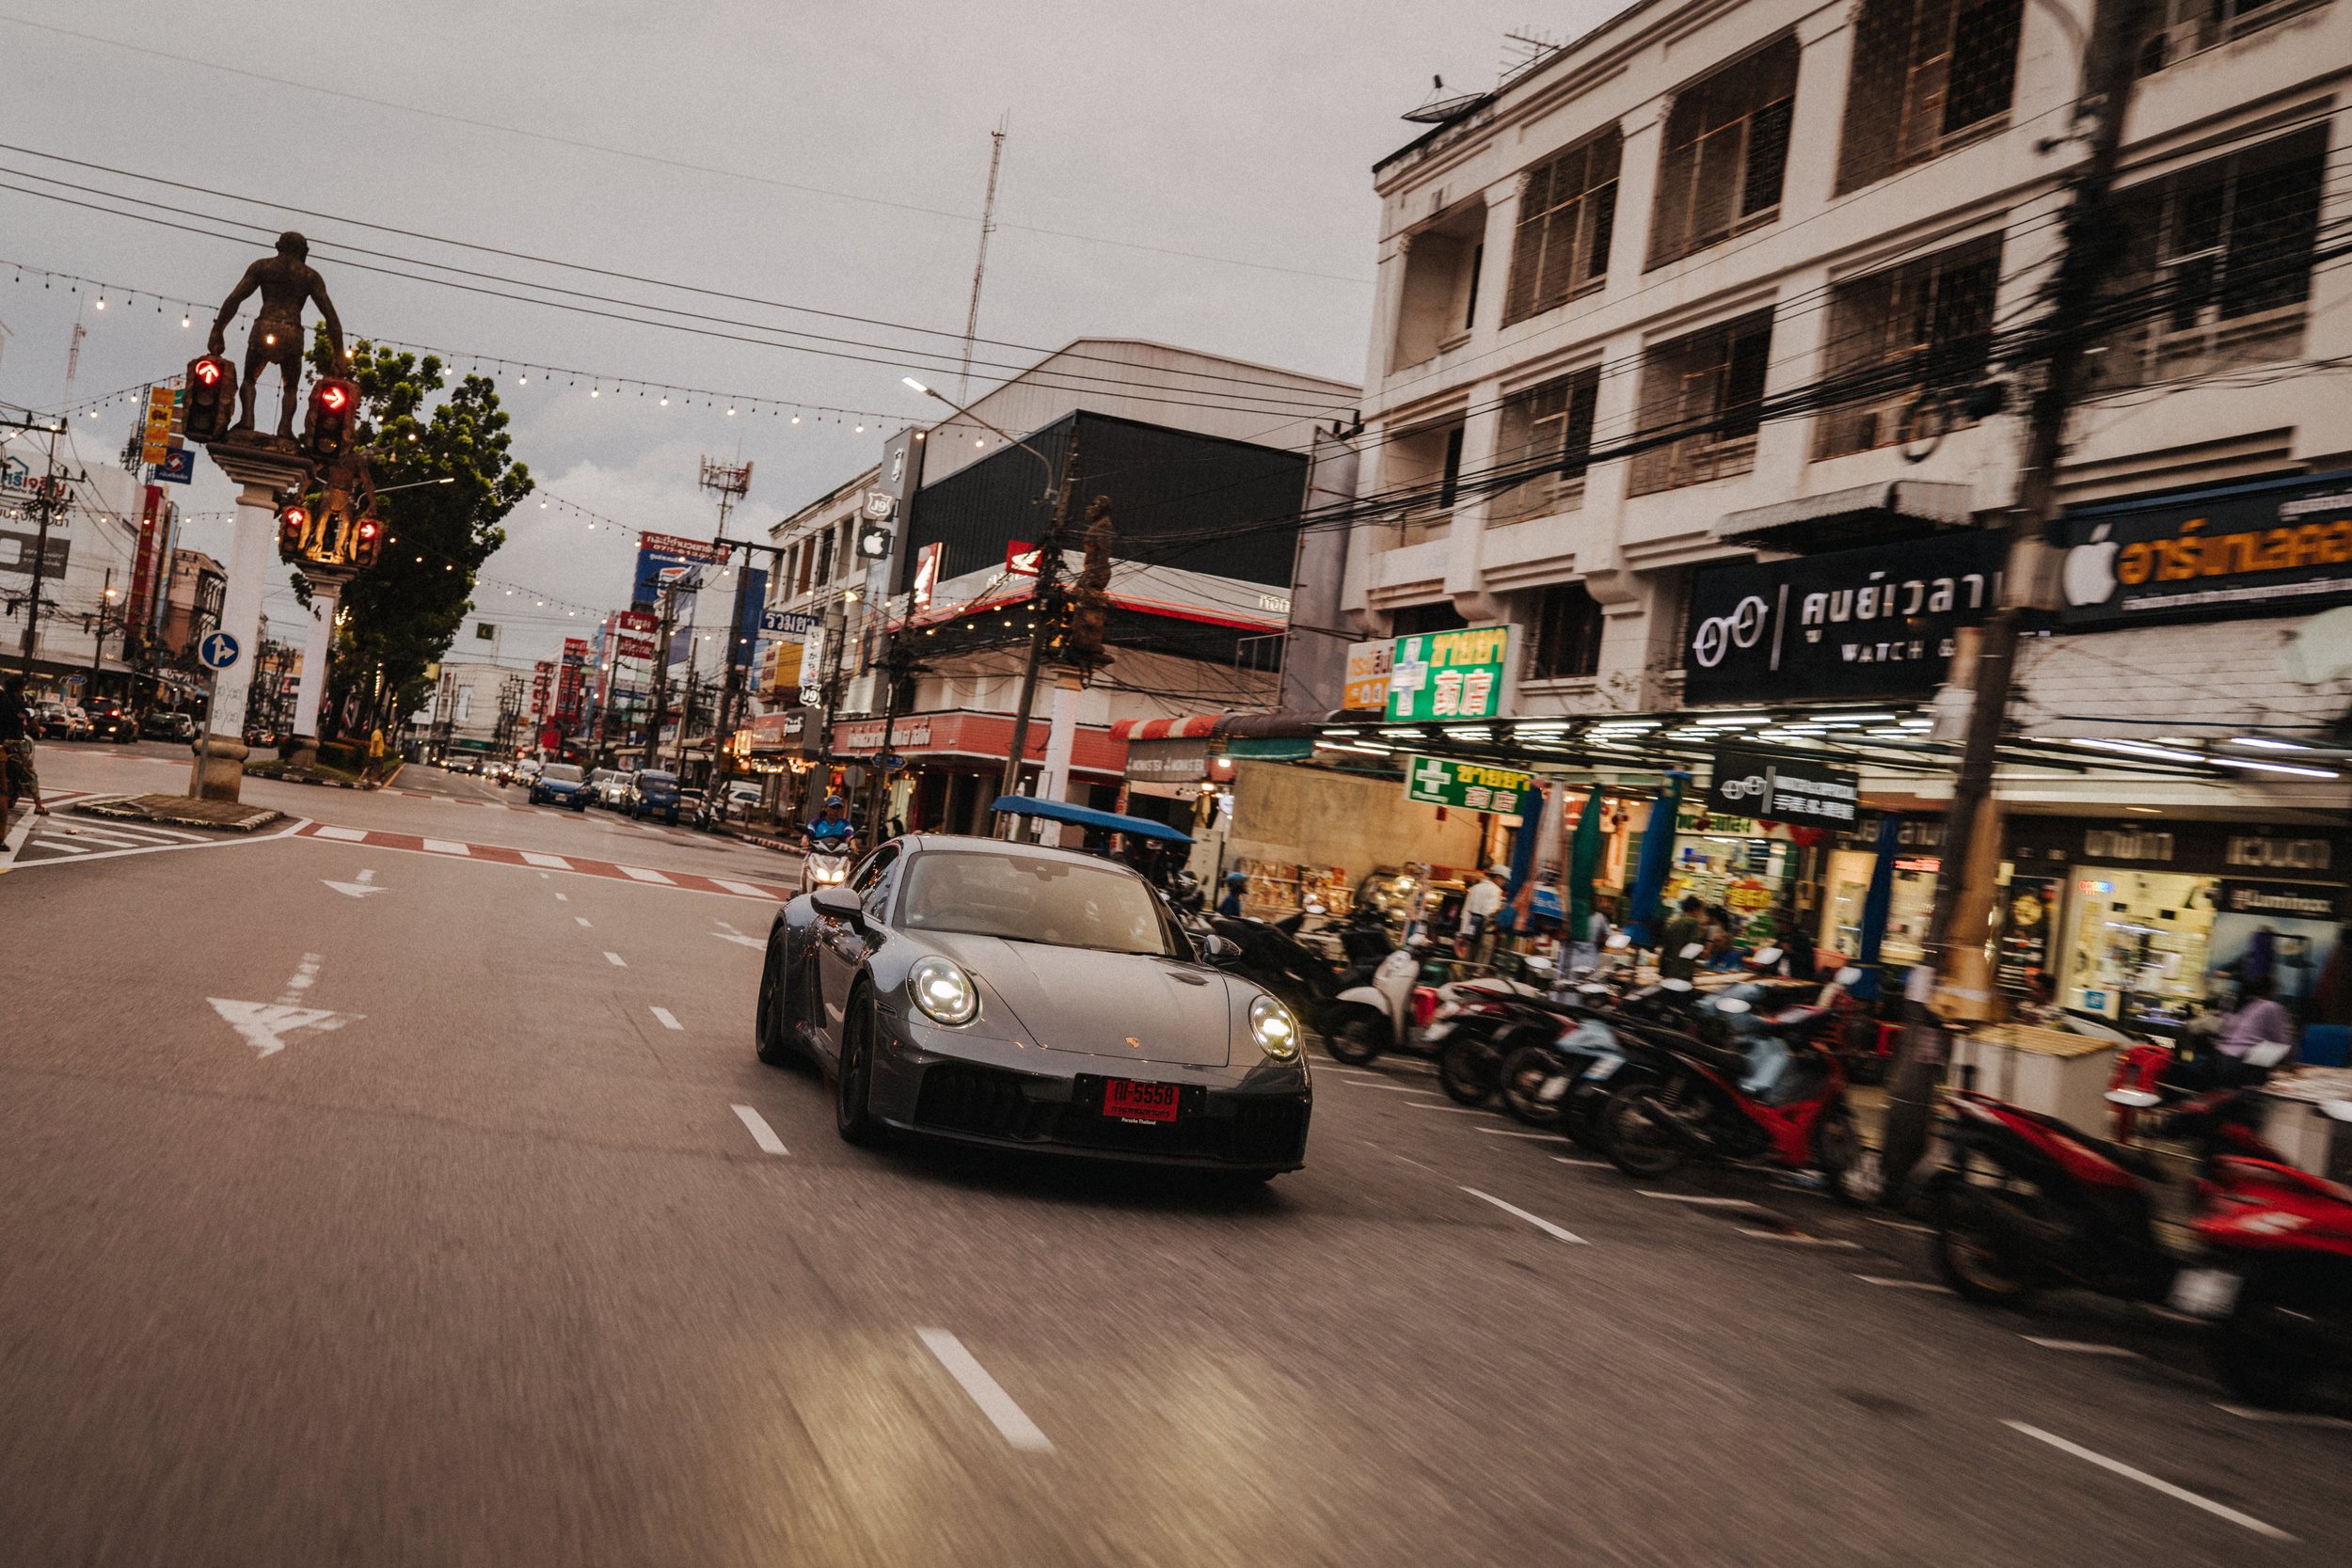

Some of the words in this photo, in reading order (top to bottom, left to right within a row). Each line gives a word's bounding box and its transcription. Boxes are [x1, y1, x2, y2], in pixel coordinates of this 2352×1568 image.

[1430, 628, 1505, 668] ขายยา
[1841, 641, 1925, 662] WATCH
[1456, 765, 1531, 791] ขายยา
